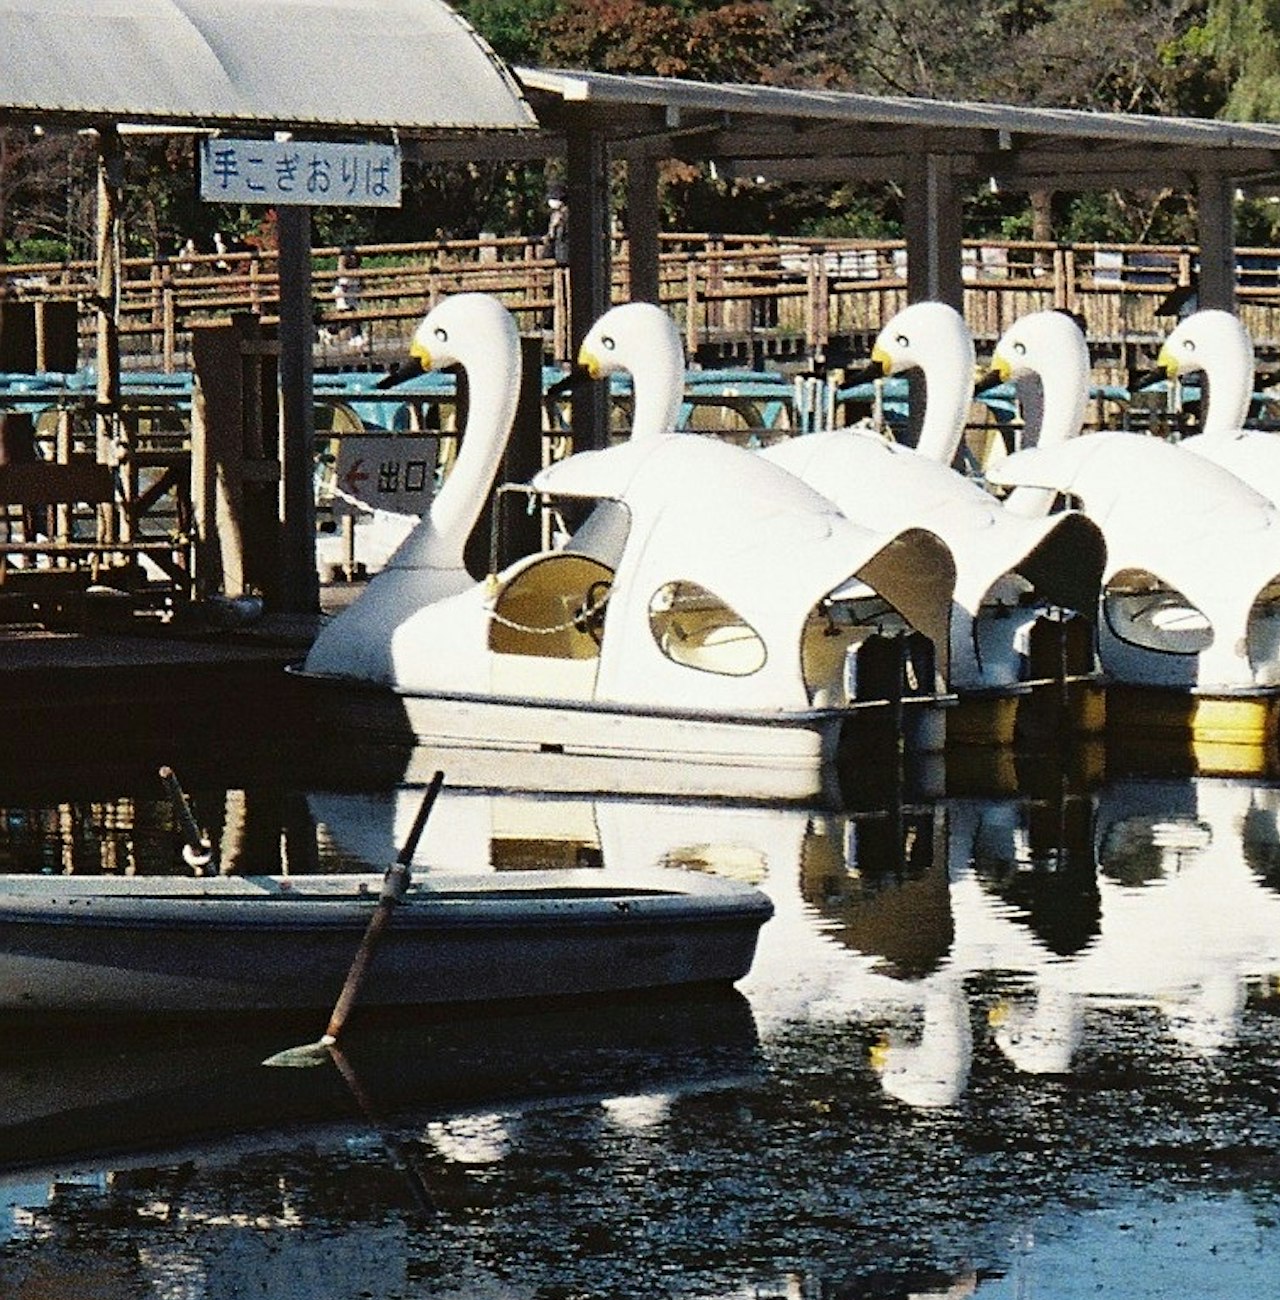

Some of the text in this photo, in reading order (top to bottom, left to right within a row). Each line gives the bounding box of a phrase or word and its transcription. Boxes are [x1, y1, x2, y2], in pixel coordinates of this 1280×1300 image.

[213, 149, 391, 197] 手こぎおりば
[378, 460, 427, 493] 出口
